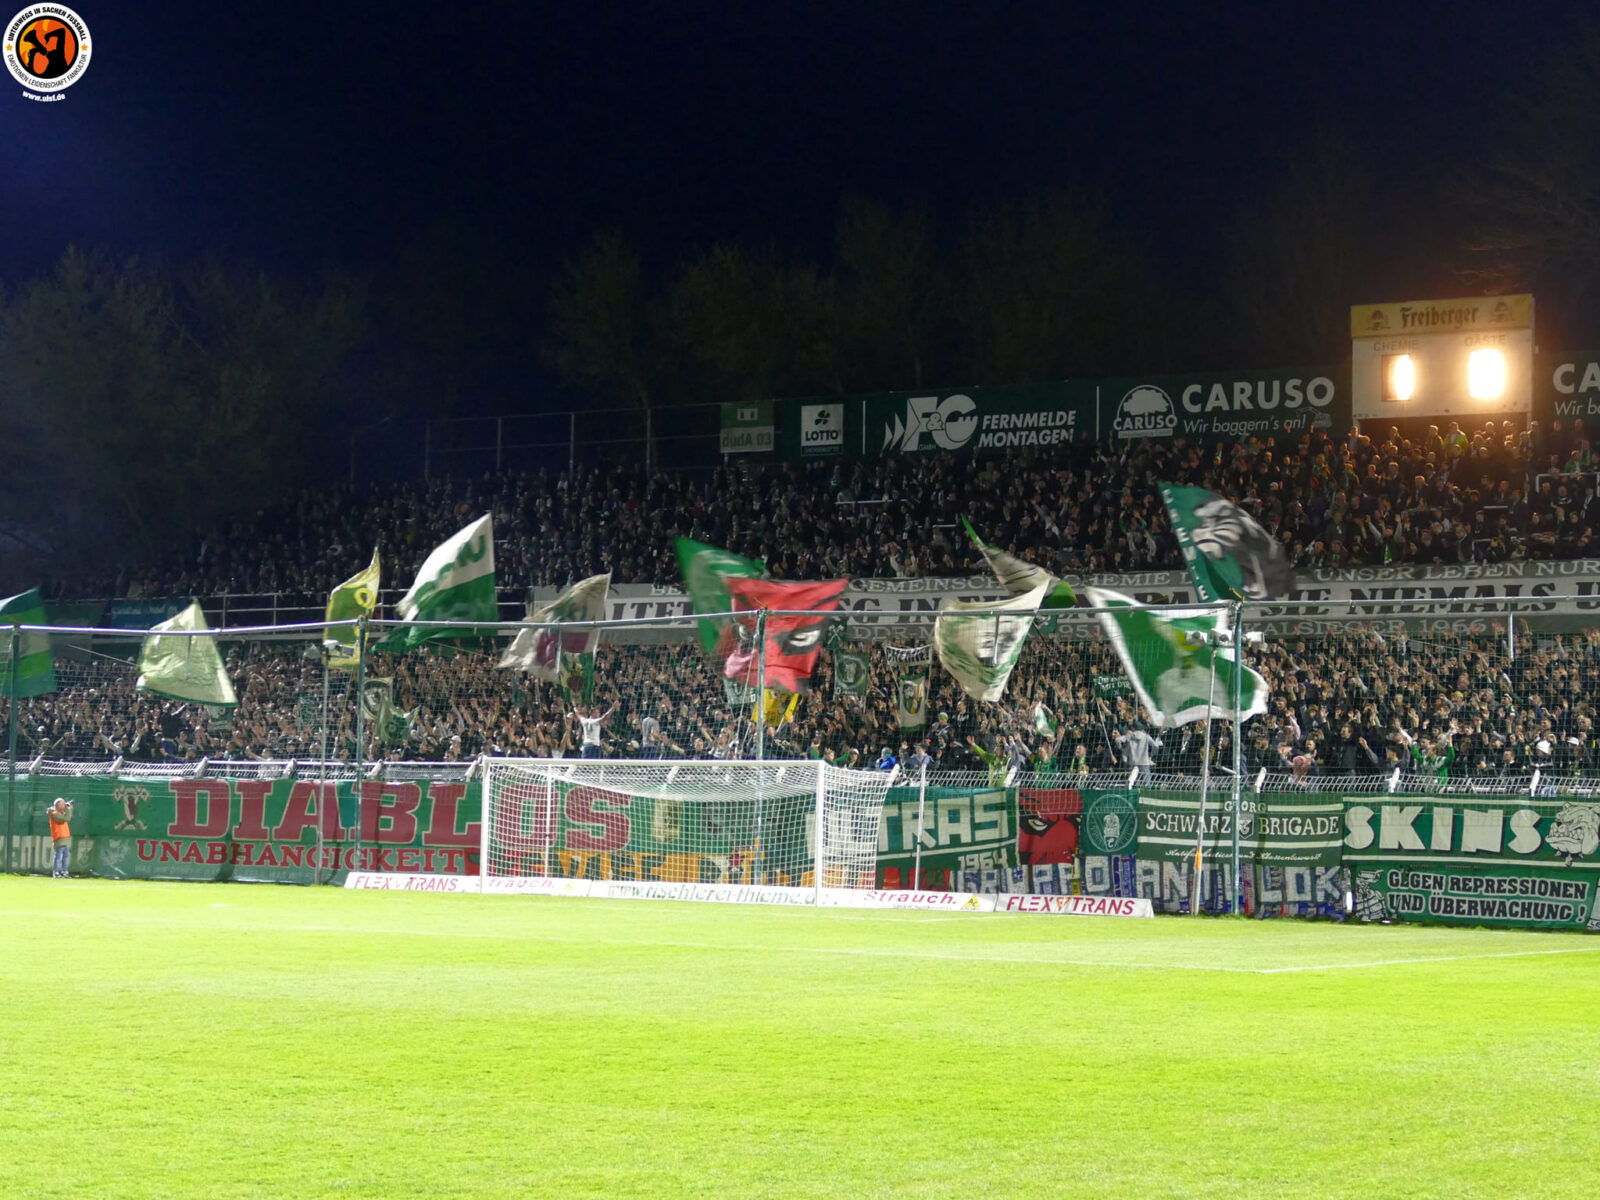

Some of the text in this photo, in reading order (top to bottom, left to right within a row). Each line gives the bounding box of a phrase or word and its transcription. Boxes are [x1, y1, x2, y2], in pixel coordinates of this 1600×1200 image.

[1400, 306, 1479, 328] Freiberger
[1373, 340, 1419, 352] CHEMIE
[1181, 376, 1335, 413] CARUSO
[1554, 399, 1583, 416] Wir
[982, 410, 1077, 430] FERNMELDE
[1113, 414, 1178, 431] CARUSO
[1184, 418, 1209, 434] Wir
[805, 430, 839, 441] LOTTO
[978, 428, 1074, 448] MONTAGEN
[1314, 566, 1415, 582] UNSER
[1424, 561, 1525, 580] LEBEN
[1347, 582, 1557, 615] NIEMALS
[168, 779, 632, 850] DIABLOS
[1224, 800, 1268, 813] GORG
[1145, 811, 1339, 836] SCHWARZ BRIGADE
[1343, 805, 1546, 855] SKINS
[958, 848, 1009, 871] 1964
[1135, 858, 1234, 901] ANTI
[1260, 864, 1341, 903] LOK
[1388, 870, 1588, 900] GEGEN REPRESSIONEN
[1388, 892, 1425, 914] UND
[1429, 890, 1573, 920] ÜBERWACHUNG
